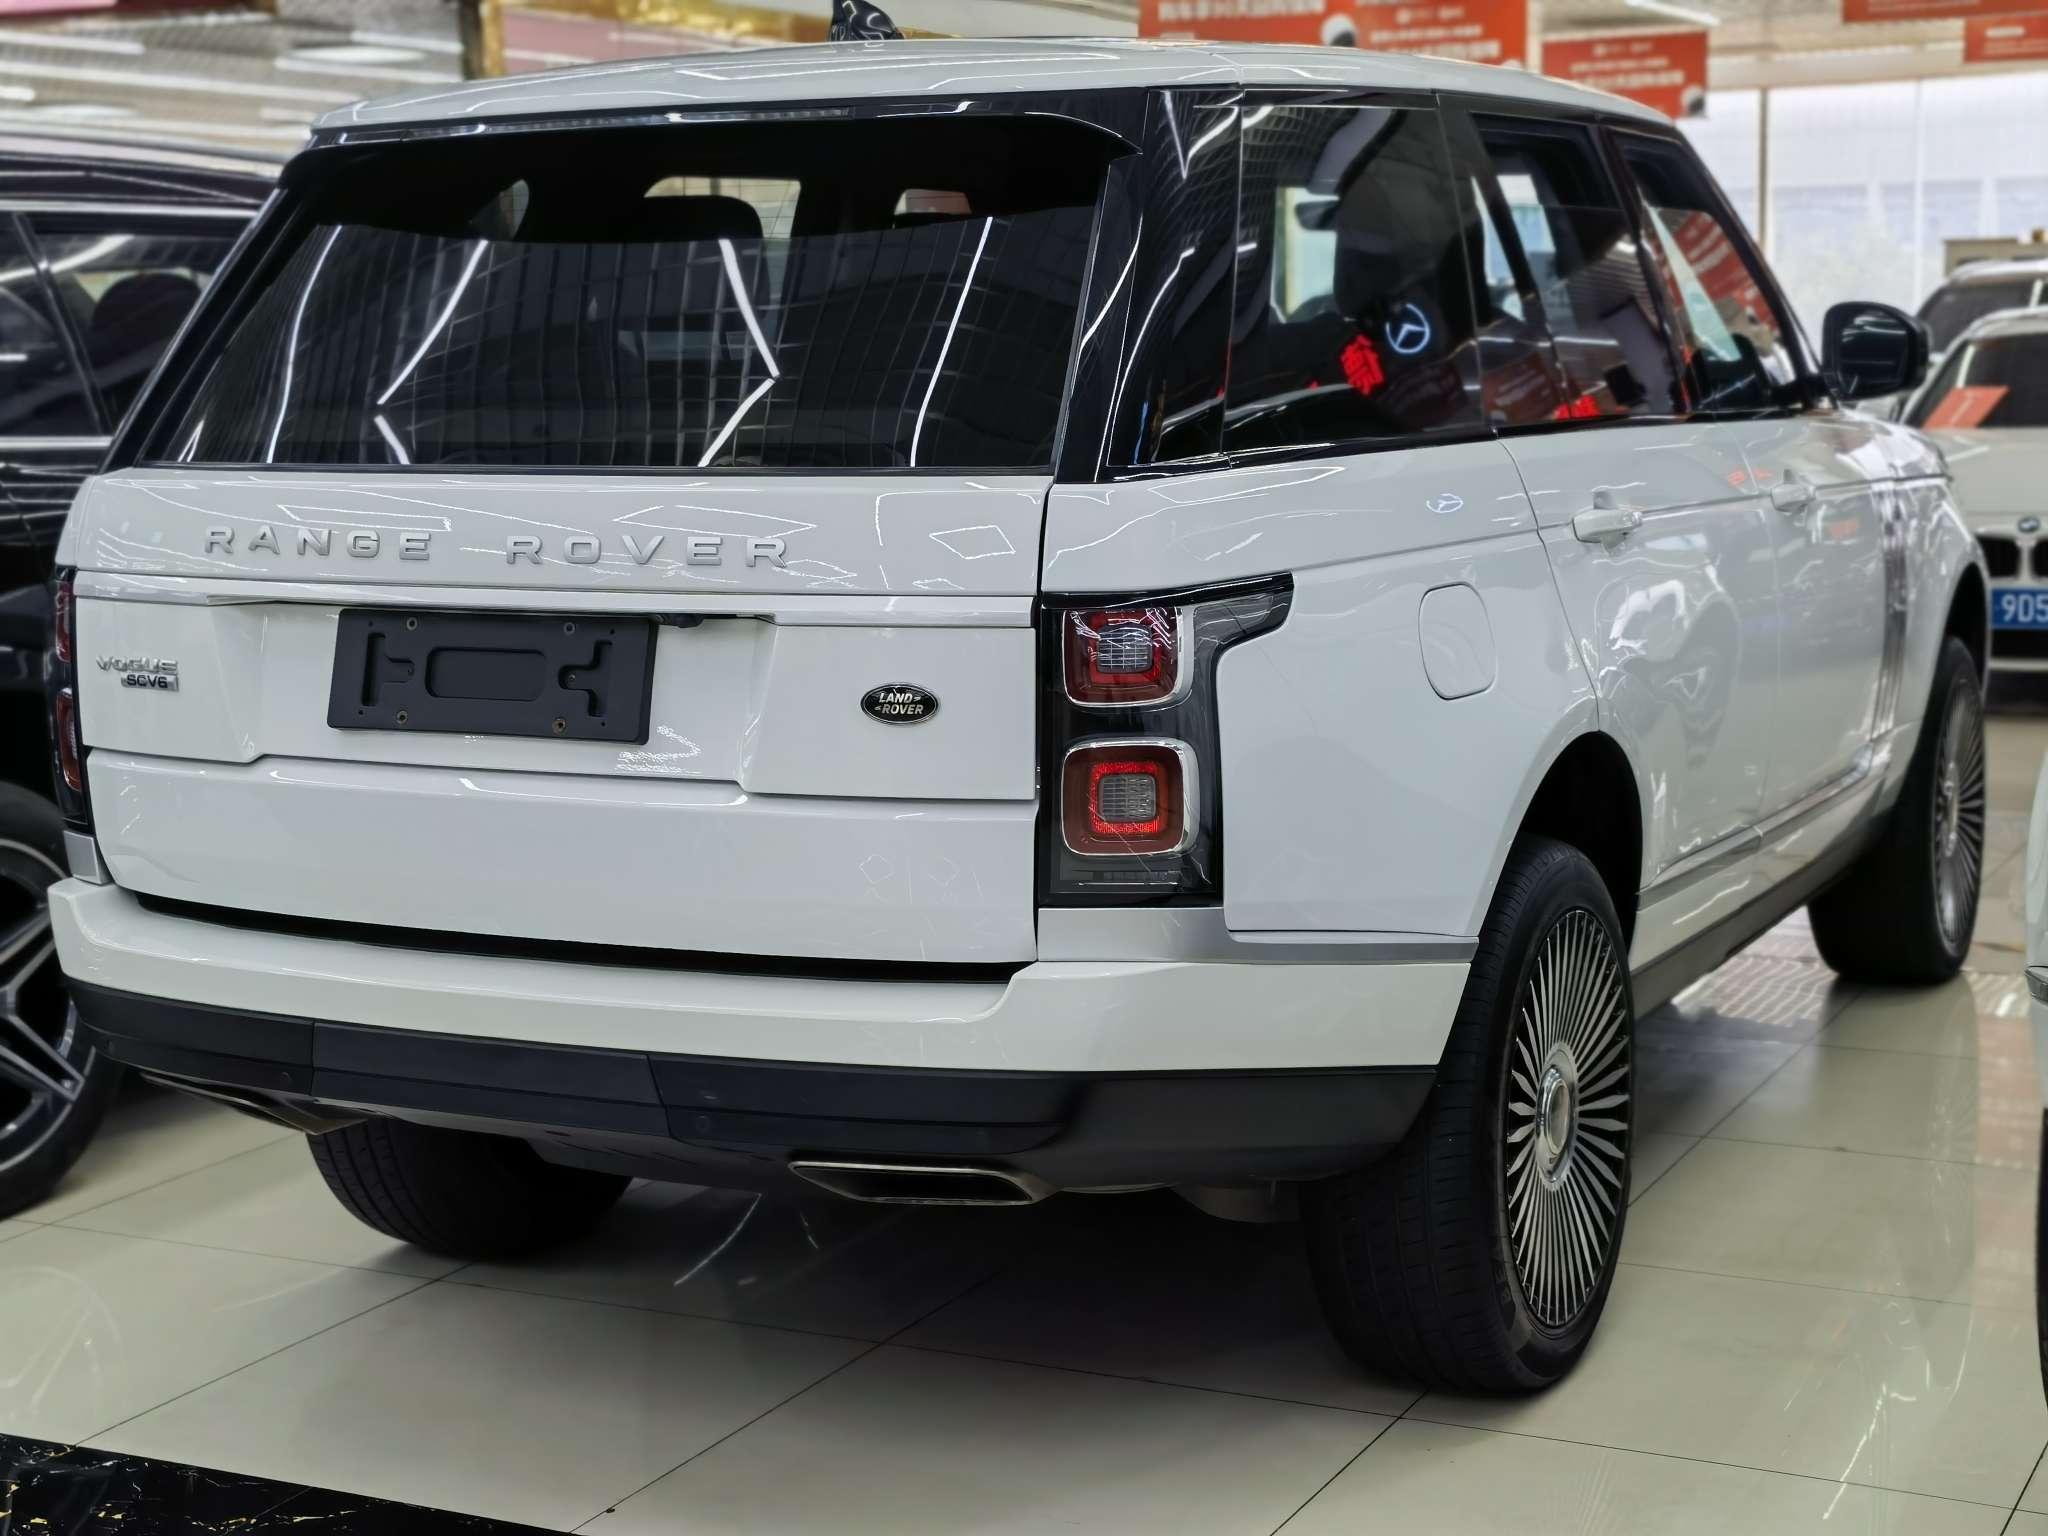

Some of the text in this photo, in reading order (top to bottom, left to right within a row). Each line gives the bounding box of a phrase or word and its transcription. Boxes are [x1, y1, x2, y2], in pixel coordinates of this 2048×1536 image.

[204, 524, 787, 568] RANGE ROVER
[879, 692, 913, 704] LAND
[882, 703, 924, 715] ROVER
